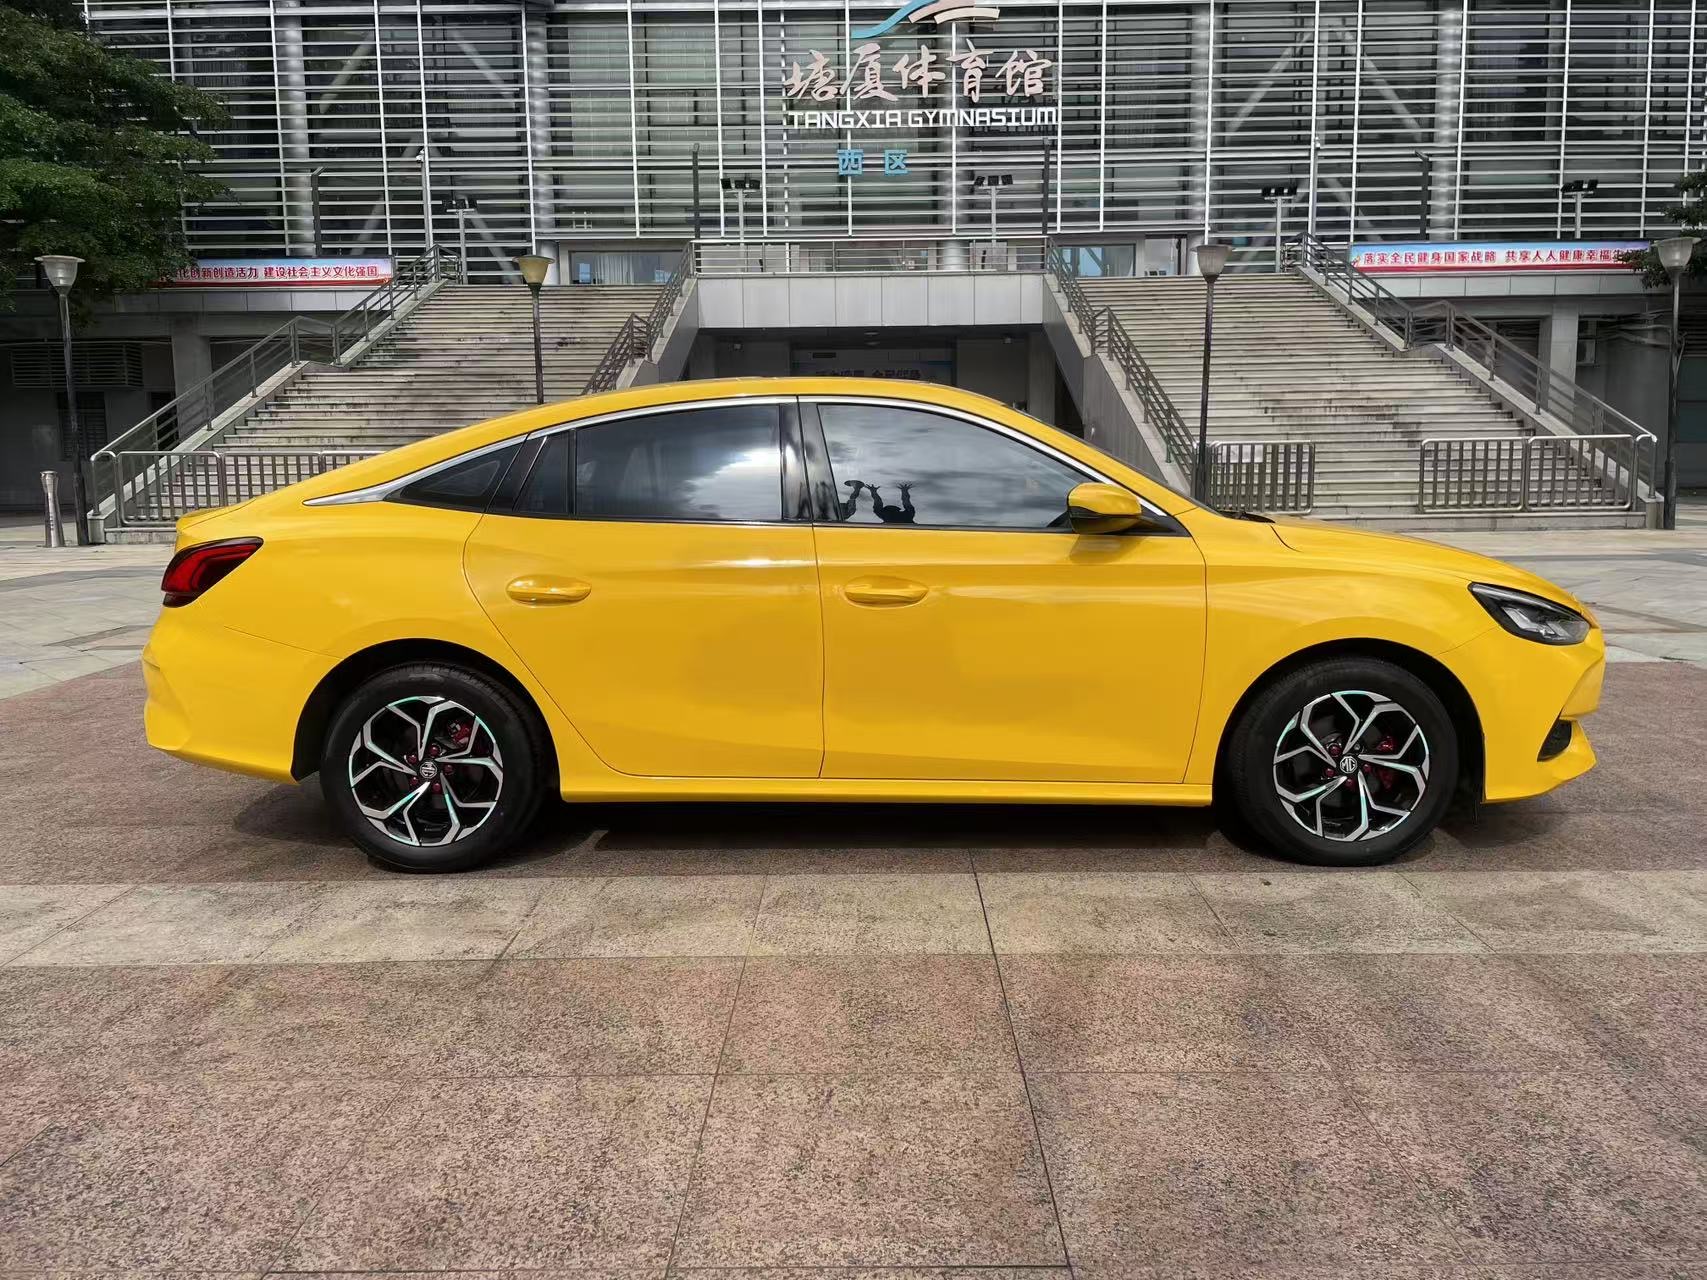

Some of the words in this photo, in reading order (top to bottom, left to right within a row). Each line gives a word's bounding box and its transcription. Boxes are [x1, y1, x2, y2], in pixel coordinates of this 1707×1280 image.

[783, 38, 1053, 102] 塘厦体育馆
[787, 110, 902, 129] TANGXIA
[908, 107, 1057, 128] GYMNASIUM
[837, 149, 908, 175] 西区
[1363, 250, 1497, 264] 落实全民健身国家战略
[263, 265, 378, 278] 建设社会主义文化强国
[1341, 757, 1356, 772] MG
